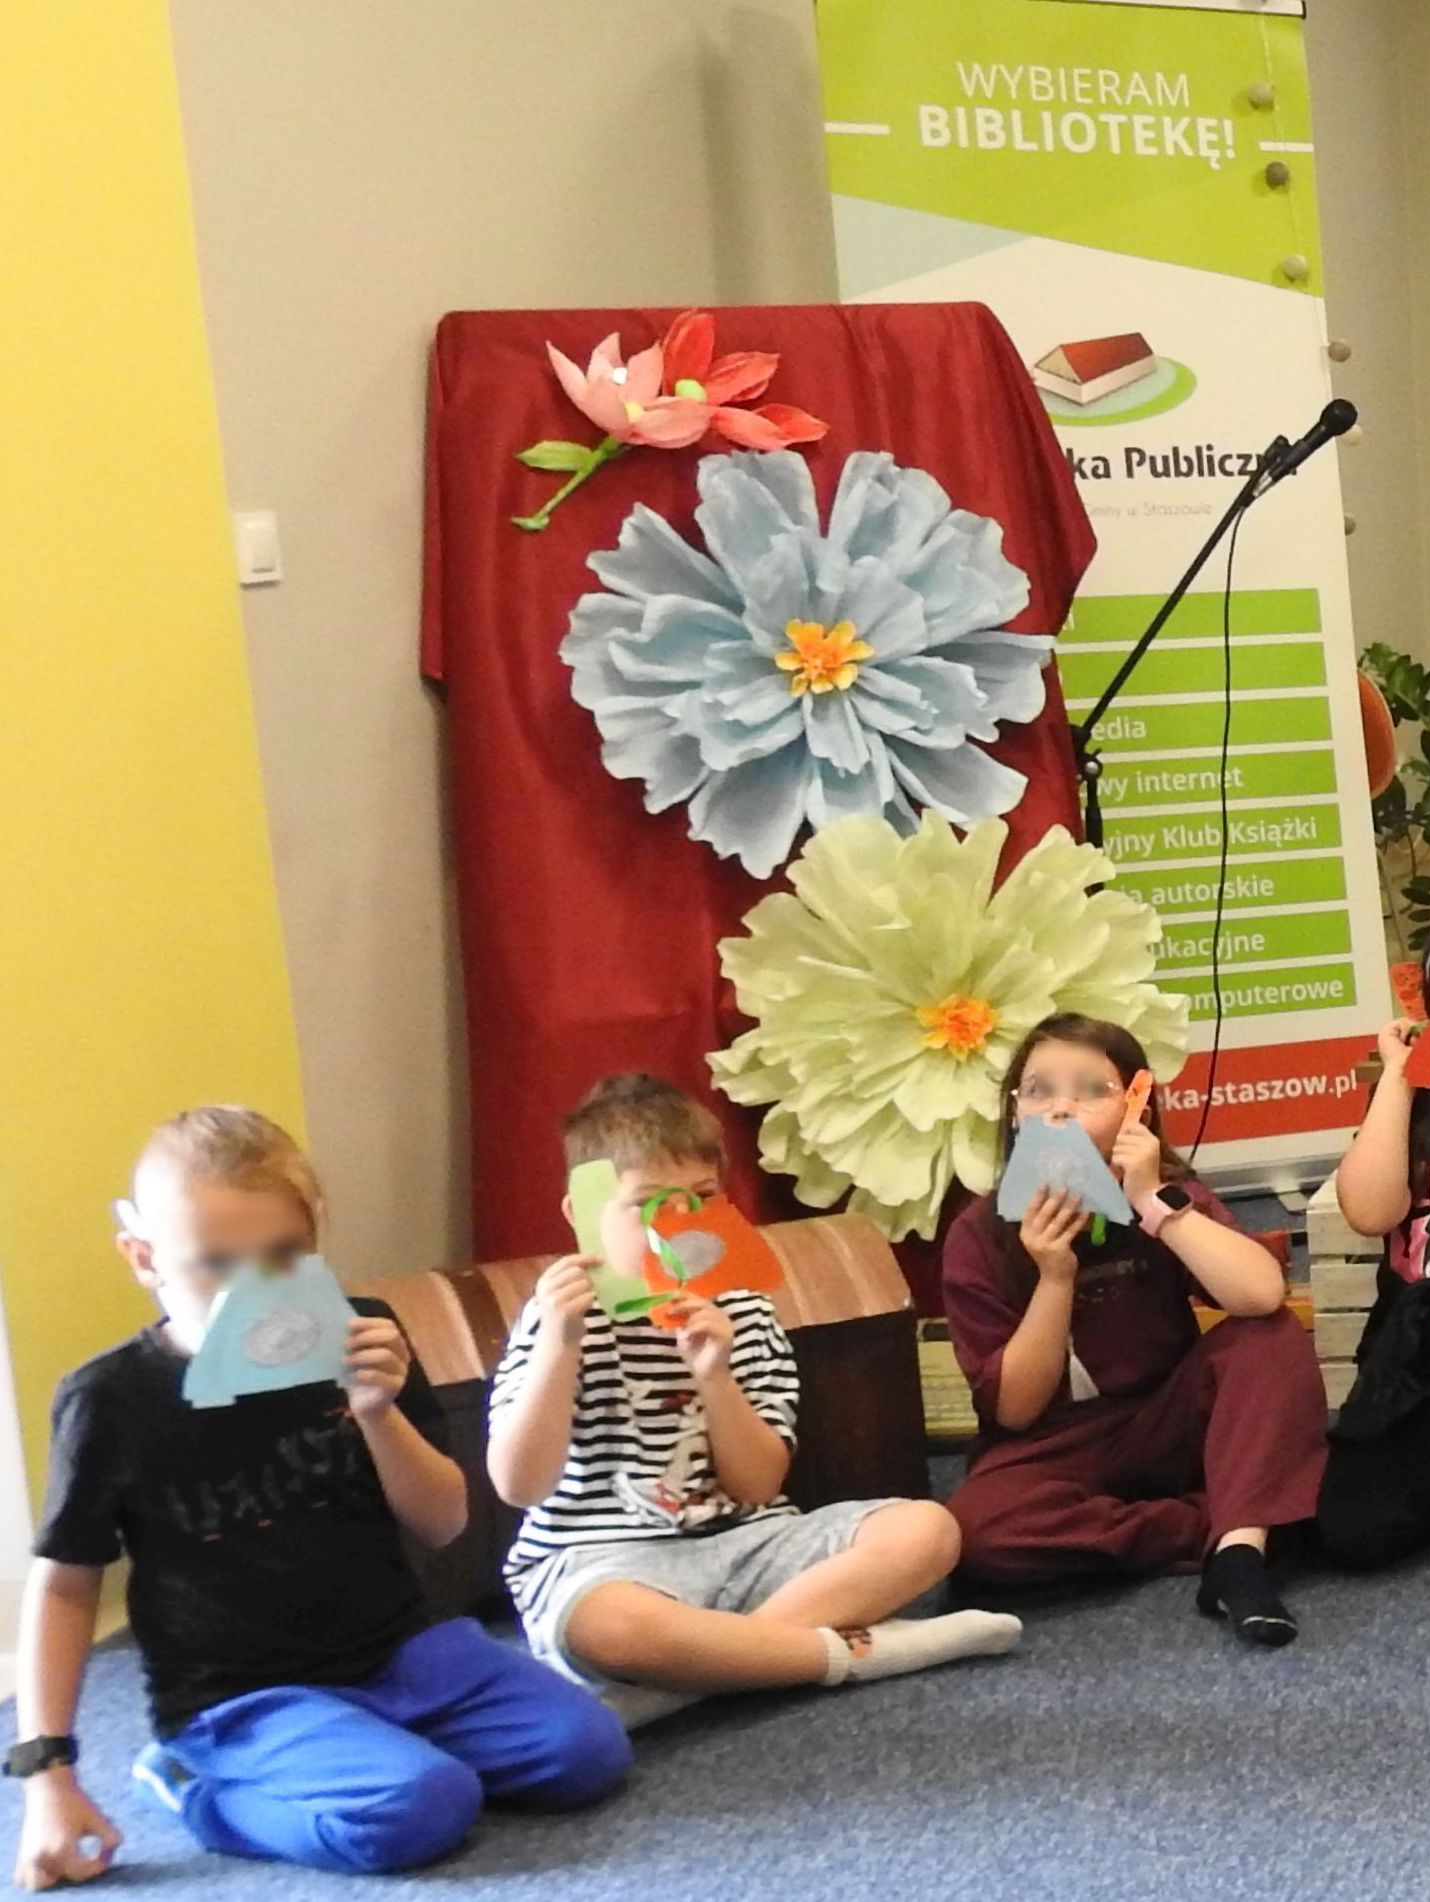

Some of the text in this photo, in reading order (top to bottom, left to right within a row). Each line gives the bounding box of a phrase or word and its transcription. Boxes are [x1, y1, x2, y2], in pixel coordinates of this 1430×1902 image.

[956, 60, 1191, 108] WYBIERAM
[918, 104, 1237, 170] BIBLIOTEKĘ!
[1124, 444, 1297, 479] Publicz
[1136, 766, 1244, 793] internet
[1162, 823, 1221, 850] Klub
[1227, 816, 1318, 849] Książki
[1150, 875, 1275, 906] autorskie
